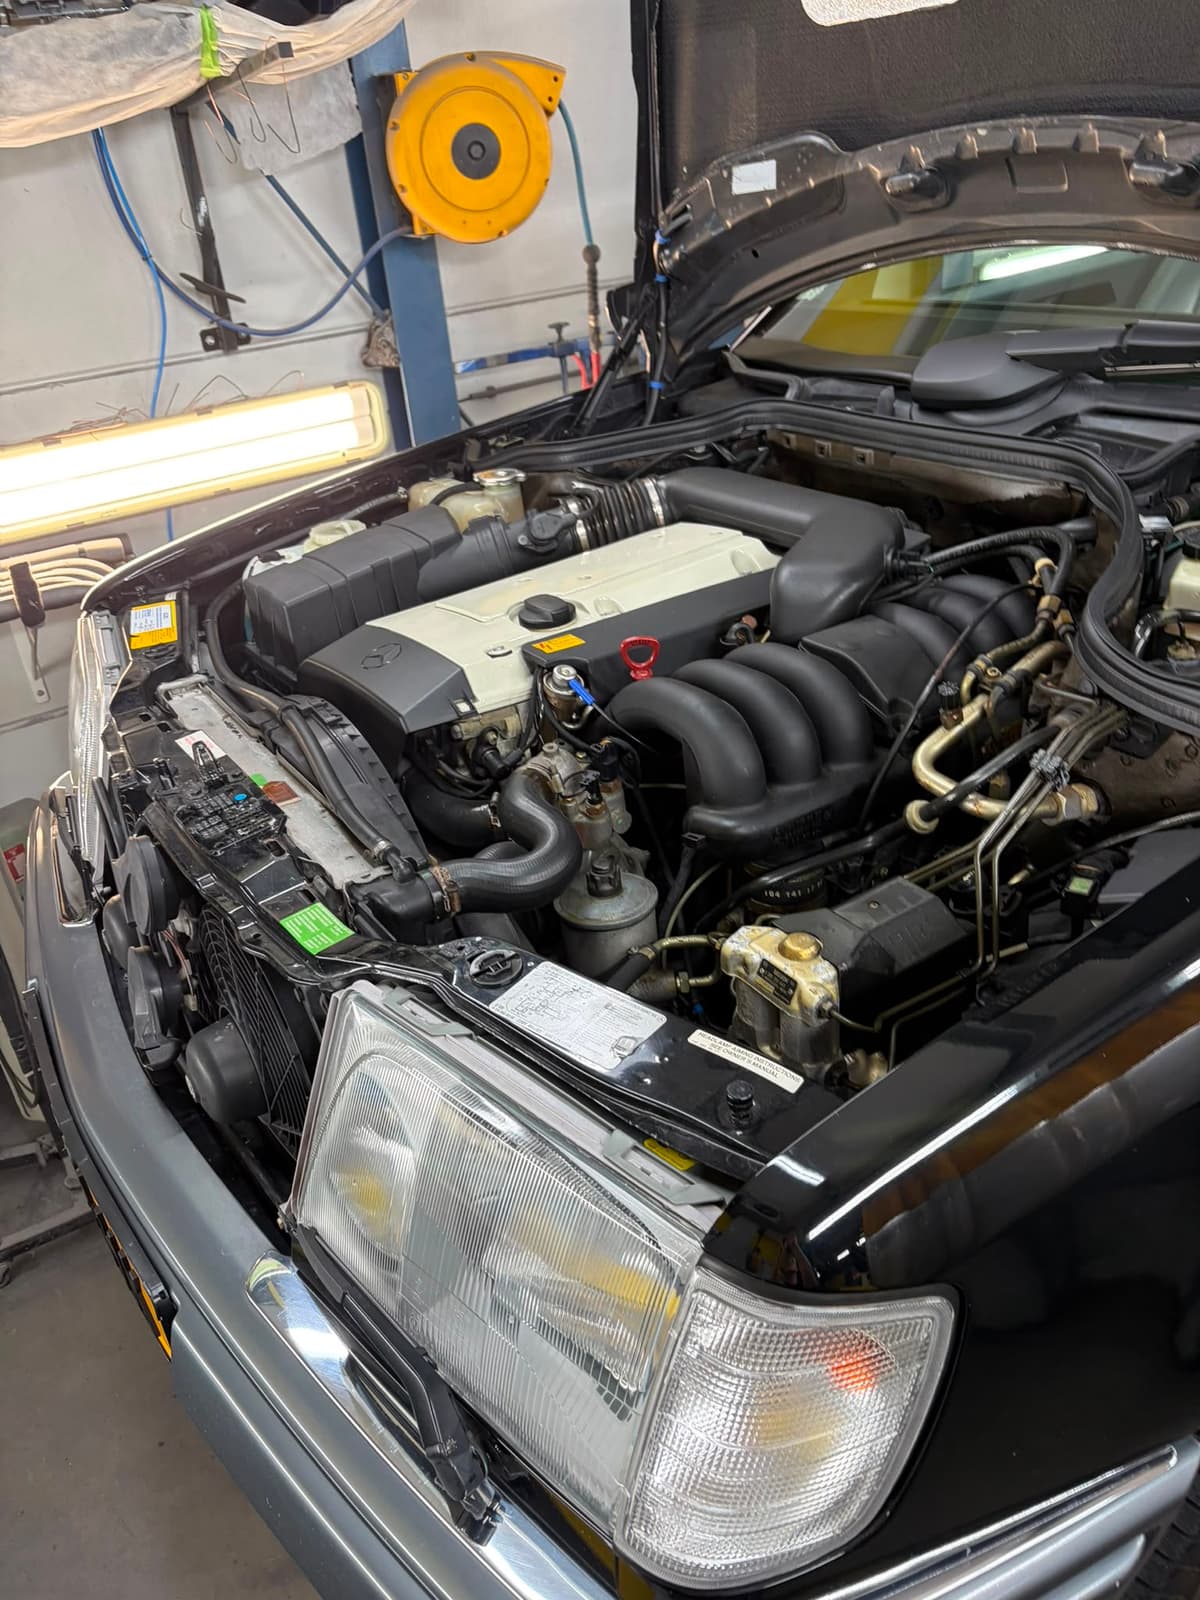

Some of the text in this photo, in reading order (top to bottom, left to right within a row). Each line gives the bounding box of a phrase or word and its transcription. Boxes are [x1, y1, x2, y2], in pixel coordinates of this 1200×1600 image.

[698, 1032, 732, 1049] HEADLAMP
[732, 1046, 754, 1059] AIMING
[753, 1057, 801, 1083] INSTRUCTIONS
[752, 1061, 779, 1078] MANUAL
